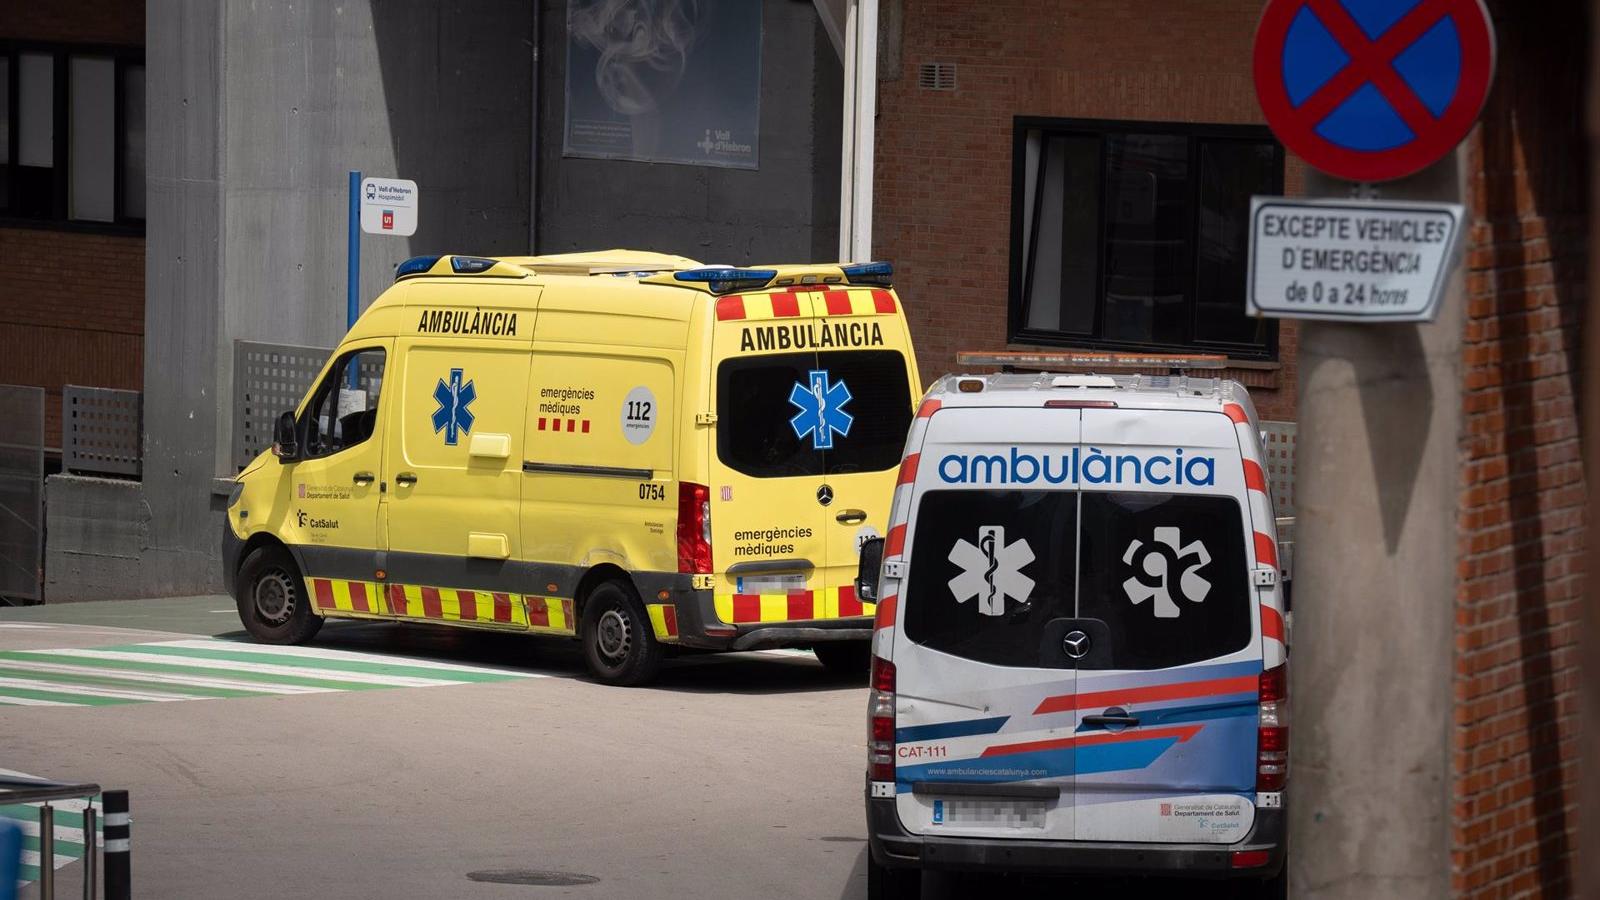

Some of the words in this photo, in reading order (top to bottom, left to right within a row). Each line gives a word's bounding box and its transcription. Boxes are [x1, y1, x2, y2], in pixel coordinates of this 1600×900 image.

[715, 130, 730, 140] Vall
[714, 141, 752, 153] d'Hebron
[1263, 214, 1351, 239] EXCEPTE
[1356, 218, 1448, 243] VEHICLES
[1285, 280, 1308, 302] de
[1312, 281, 1324, 303] 0
[1328, 287, 1339, 304] a
[1343, 282, 1365, 304] 24
[417, 306, 517, 336] AMBULÀNCIA
[740, 318, 884, 352] AMBULÀNCIA
[540, 386, 595, 401] emergències
[539, 401, 581, 416] mèdiques
[627, 401, 651, 421] 112
[938, 447, 1215, 486] ambulància
[639, 483, 665, 501] 0754
[310, 519, 339, 529] CatSalut
[734, 526, 812, 542] emergències
[734, 543, 794, 557] mèdiques
[898, 746, 946, 758] CAT-111
[927, 767, 1048, 777] www.ambulanciescatalunya.com
